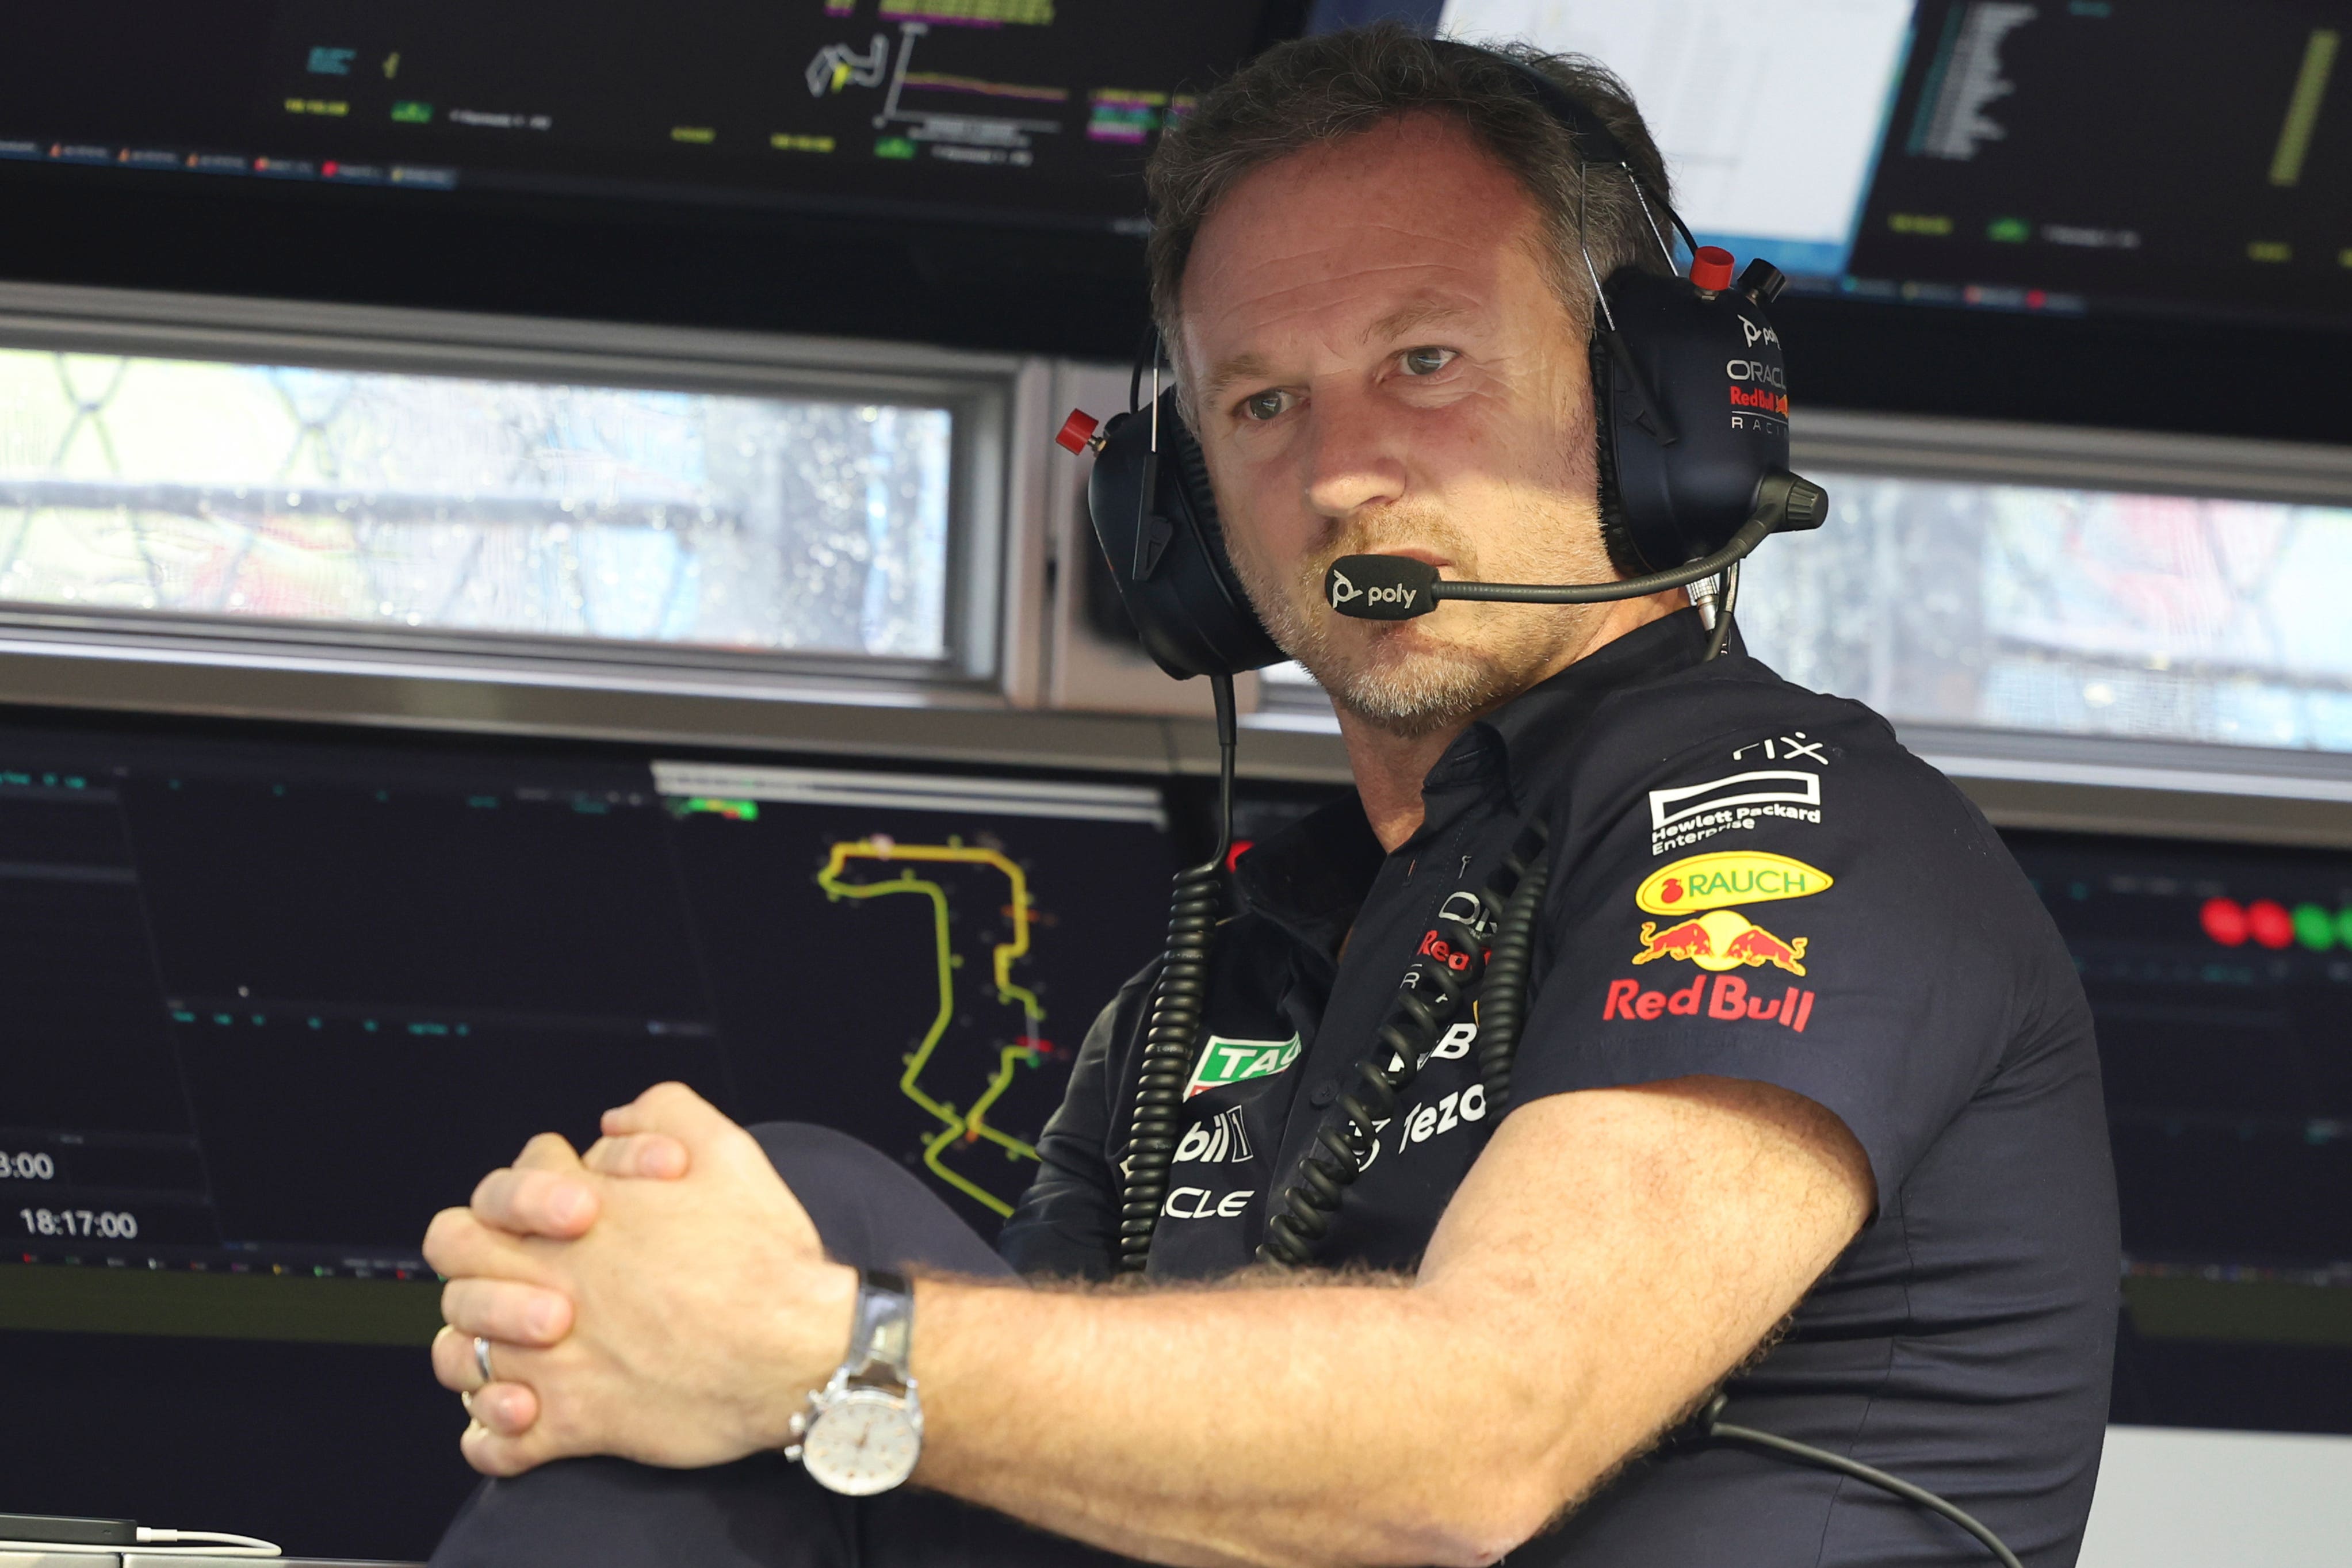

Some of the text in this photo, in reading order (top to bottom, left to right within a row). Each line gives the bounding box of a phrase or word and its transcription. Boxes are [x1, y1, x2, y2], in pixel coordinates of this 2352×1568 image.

[1726, 360, 1787, 391] ORACL
[1730, 386, 1758, 407] Red
[1368, 583, 1417, 609] poly
[1652, 804, 1821, 843] Hewlett Packard
[1689, 870, 1806, 897] RAUCH
[1603, 974, 1815, 1032] Red Bull
[1398, 1084, 1486, 1155] Tezo
[1172, 1113, 1229, 1164] bil
[1160, 1187, 1255, 1219] CLE
[20, 1208, 138, 1239] 18:17:00
